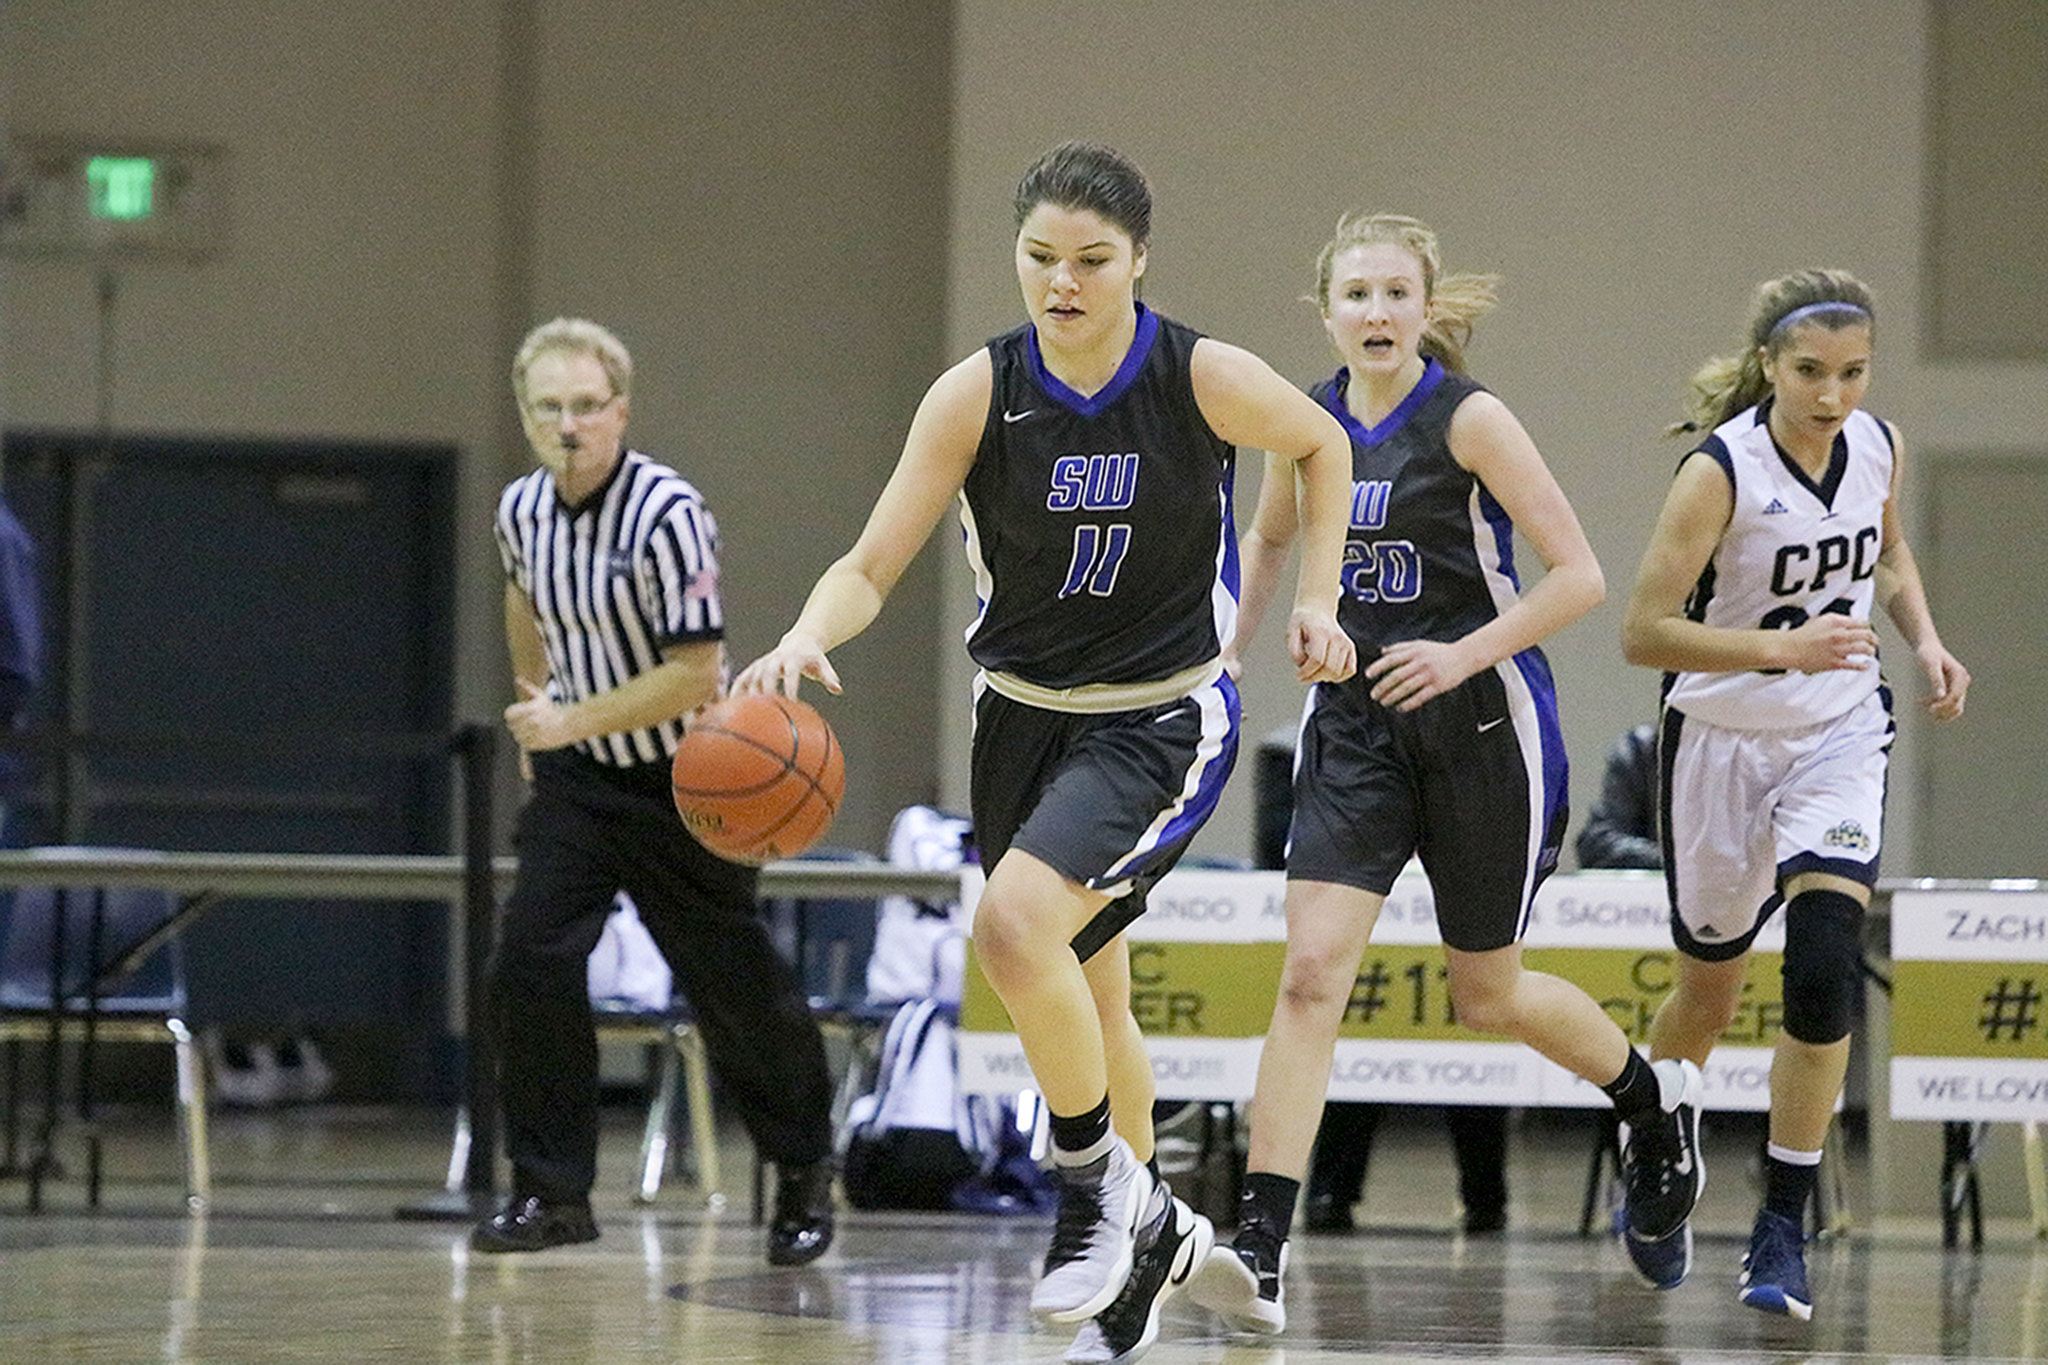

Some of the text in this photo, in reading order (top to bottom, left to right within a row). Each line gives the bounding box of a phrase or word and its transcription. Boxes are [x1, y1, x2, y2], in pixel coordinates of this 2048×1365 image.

[1047, 453, 1139, 511] SW
[1351, 481, 1392, 530] W
[1059, 524, 1133, 600] 11
[1338, 540, 1422, 603] 20
[1770, 526, 1878, 596] CPC
[1946, 910, 2046, 941] ZACH
[1917, 1076, 2048, 1102] WE LOV
